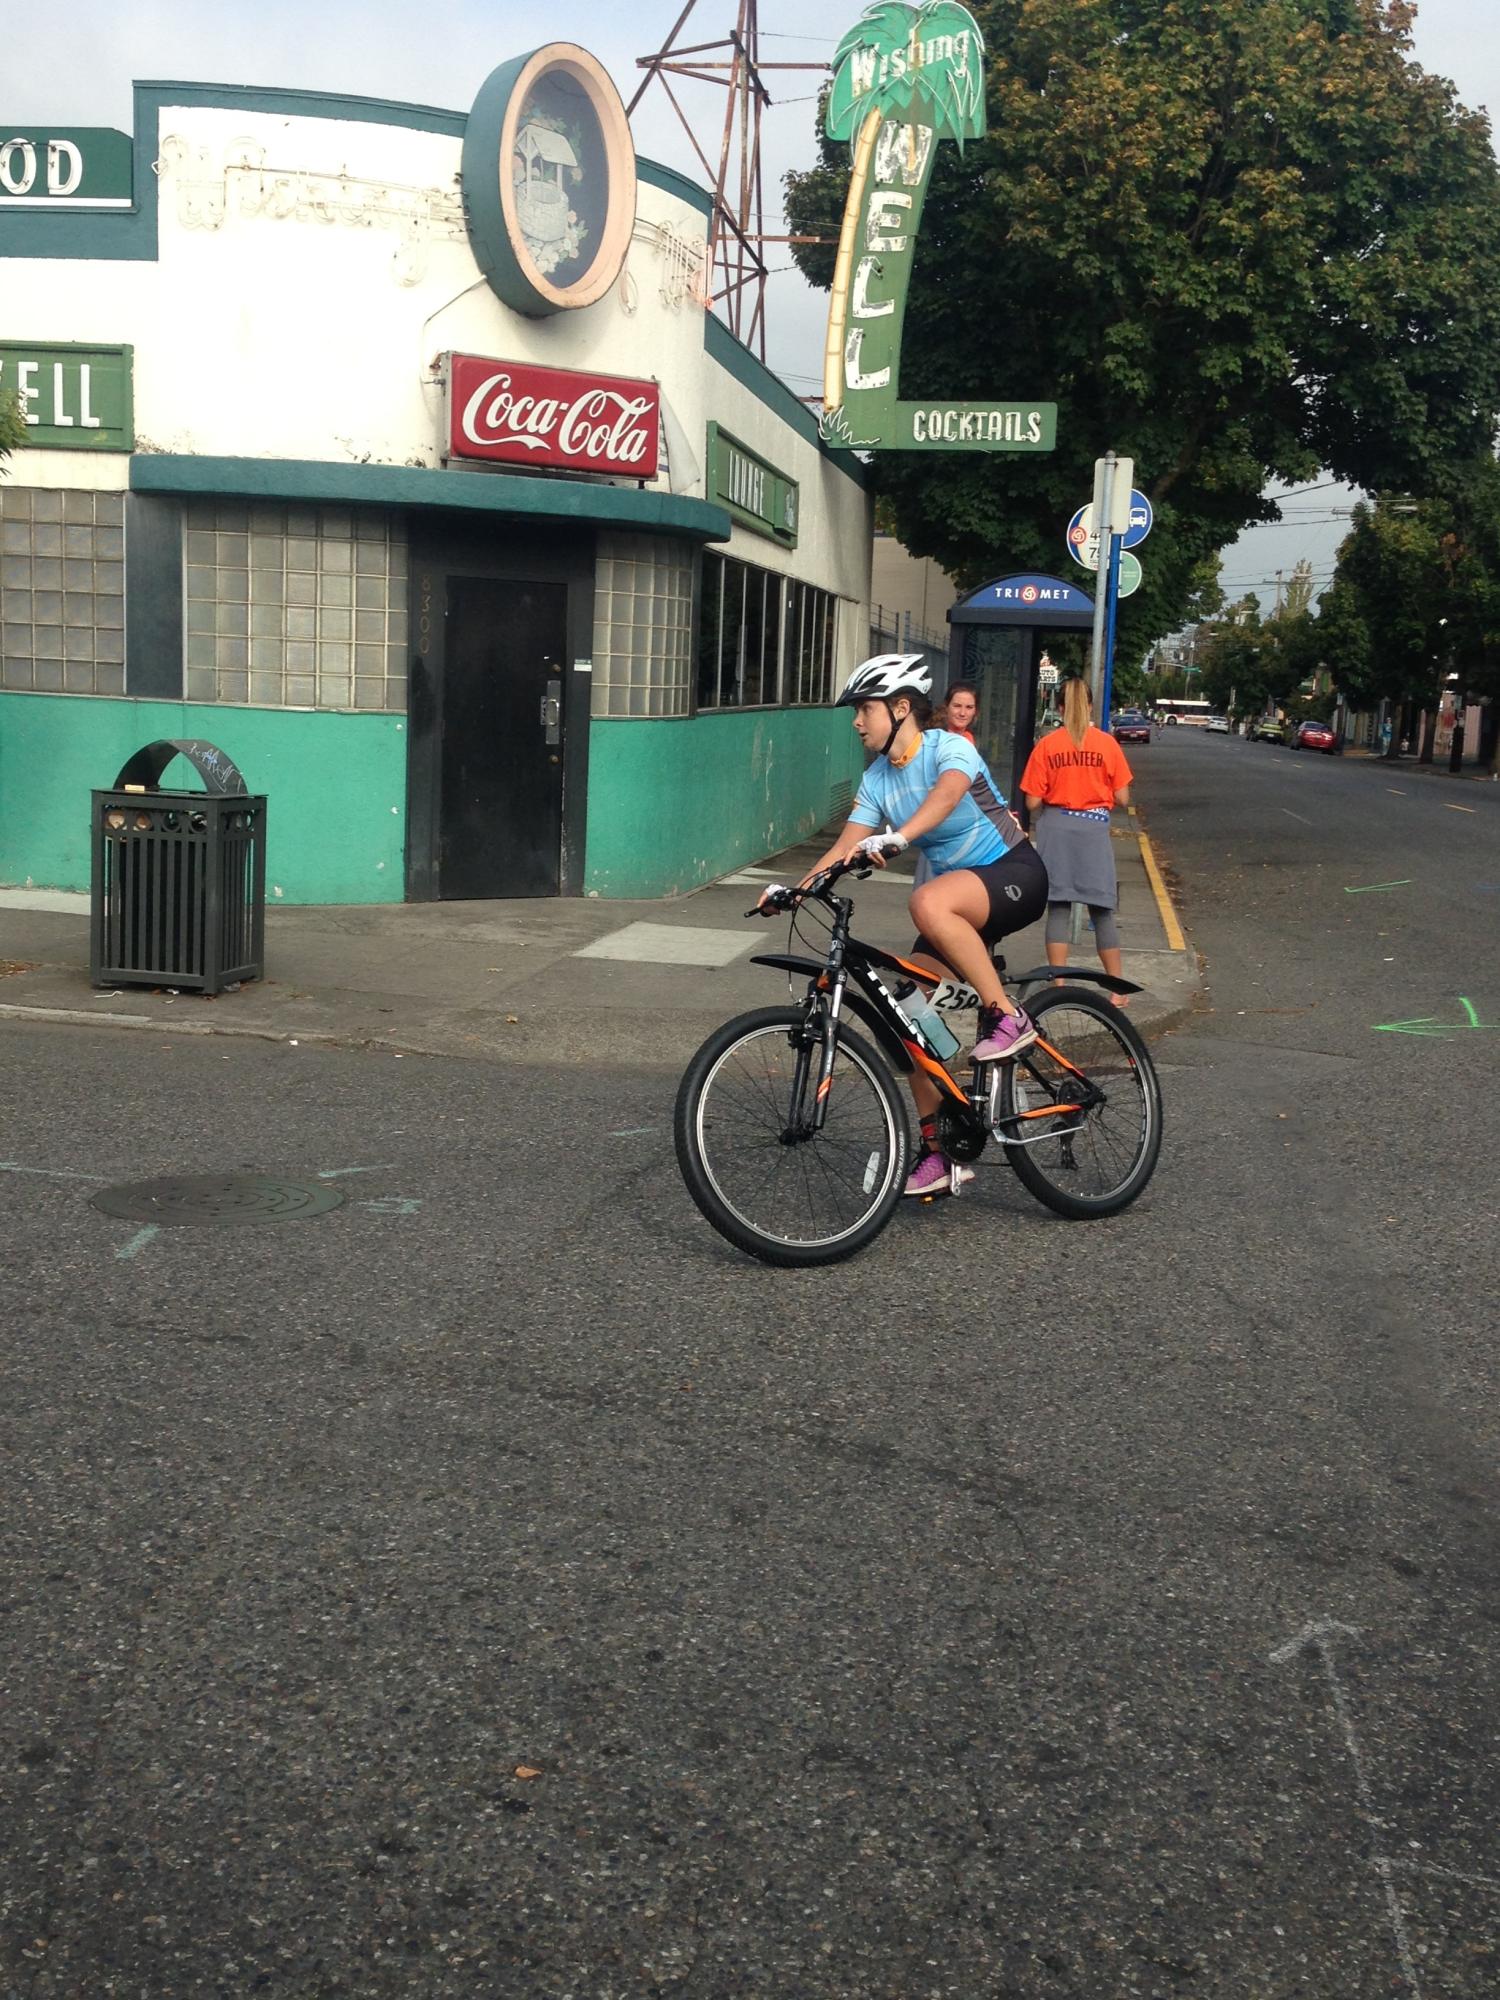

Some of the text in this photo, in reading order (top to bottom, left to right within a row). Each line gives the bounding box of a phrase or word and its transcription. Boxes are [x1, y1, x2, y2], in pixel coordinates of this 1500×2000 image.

[851, 29, 970, 98] Wishing
[845, 120, 932, 390] WELL
[0, 360, 100, 428] ELL
[462, 373, 655, 463] Coca-Cola
[913, 409, 1042, 444] COCKTAILS
[995, 587, 1070, 600] TRI MET
[1047, 751, 1103, 770] VOLUNTEER
[866, 969, 927, 1049] TREK
